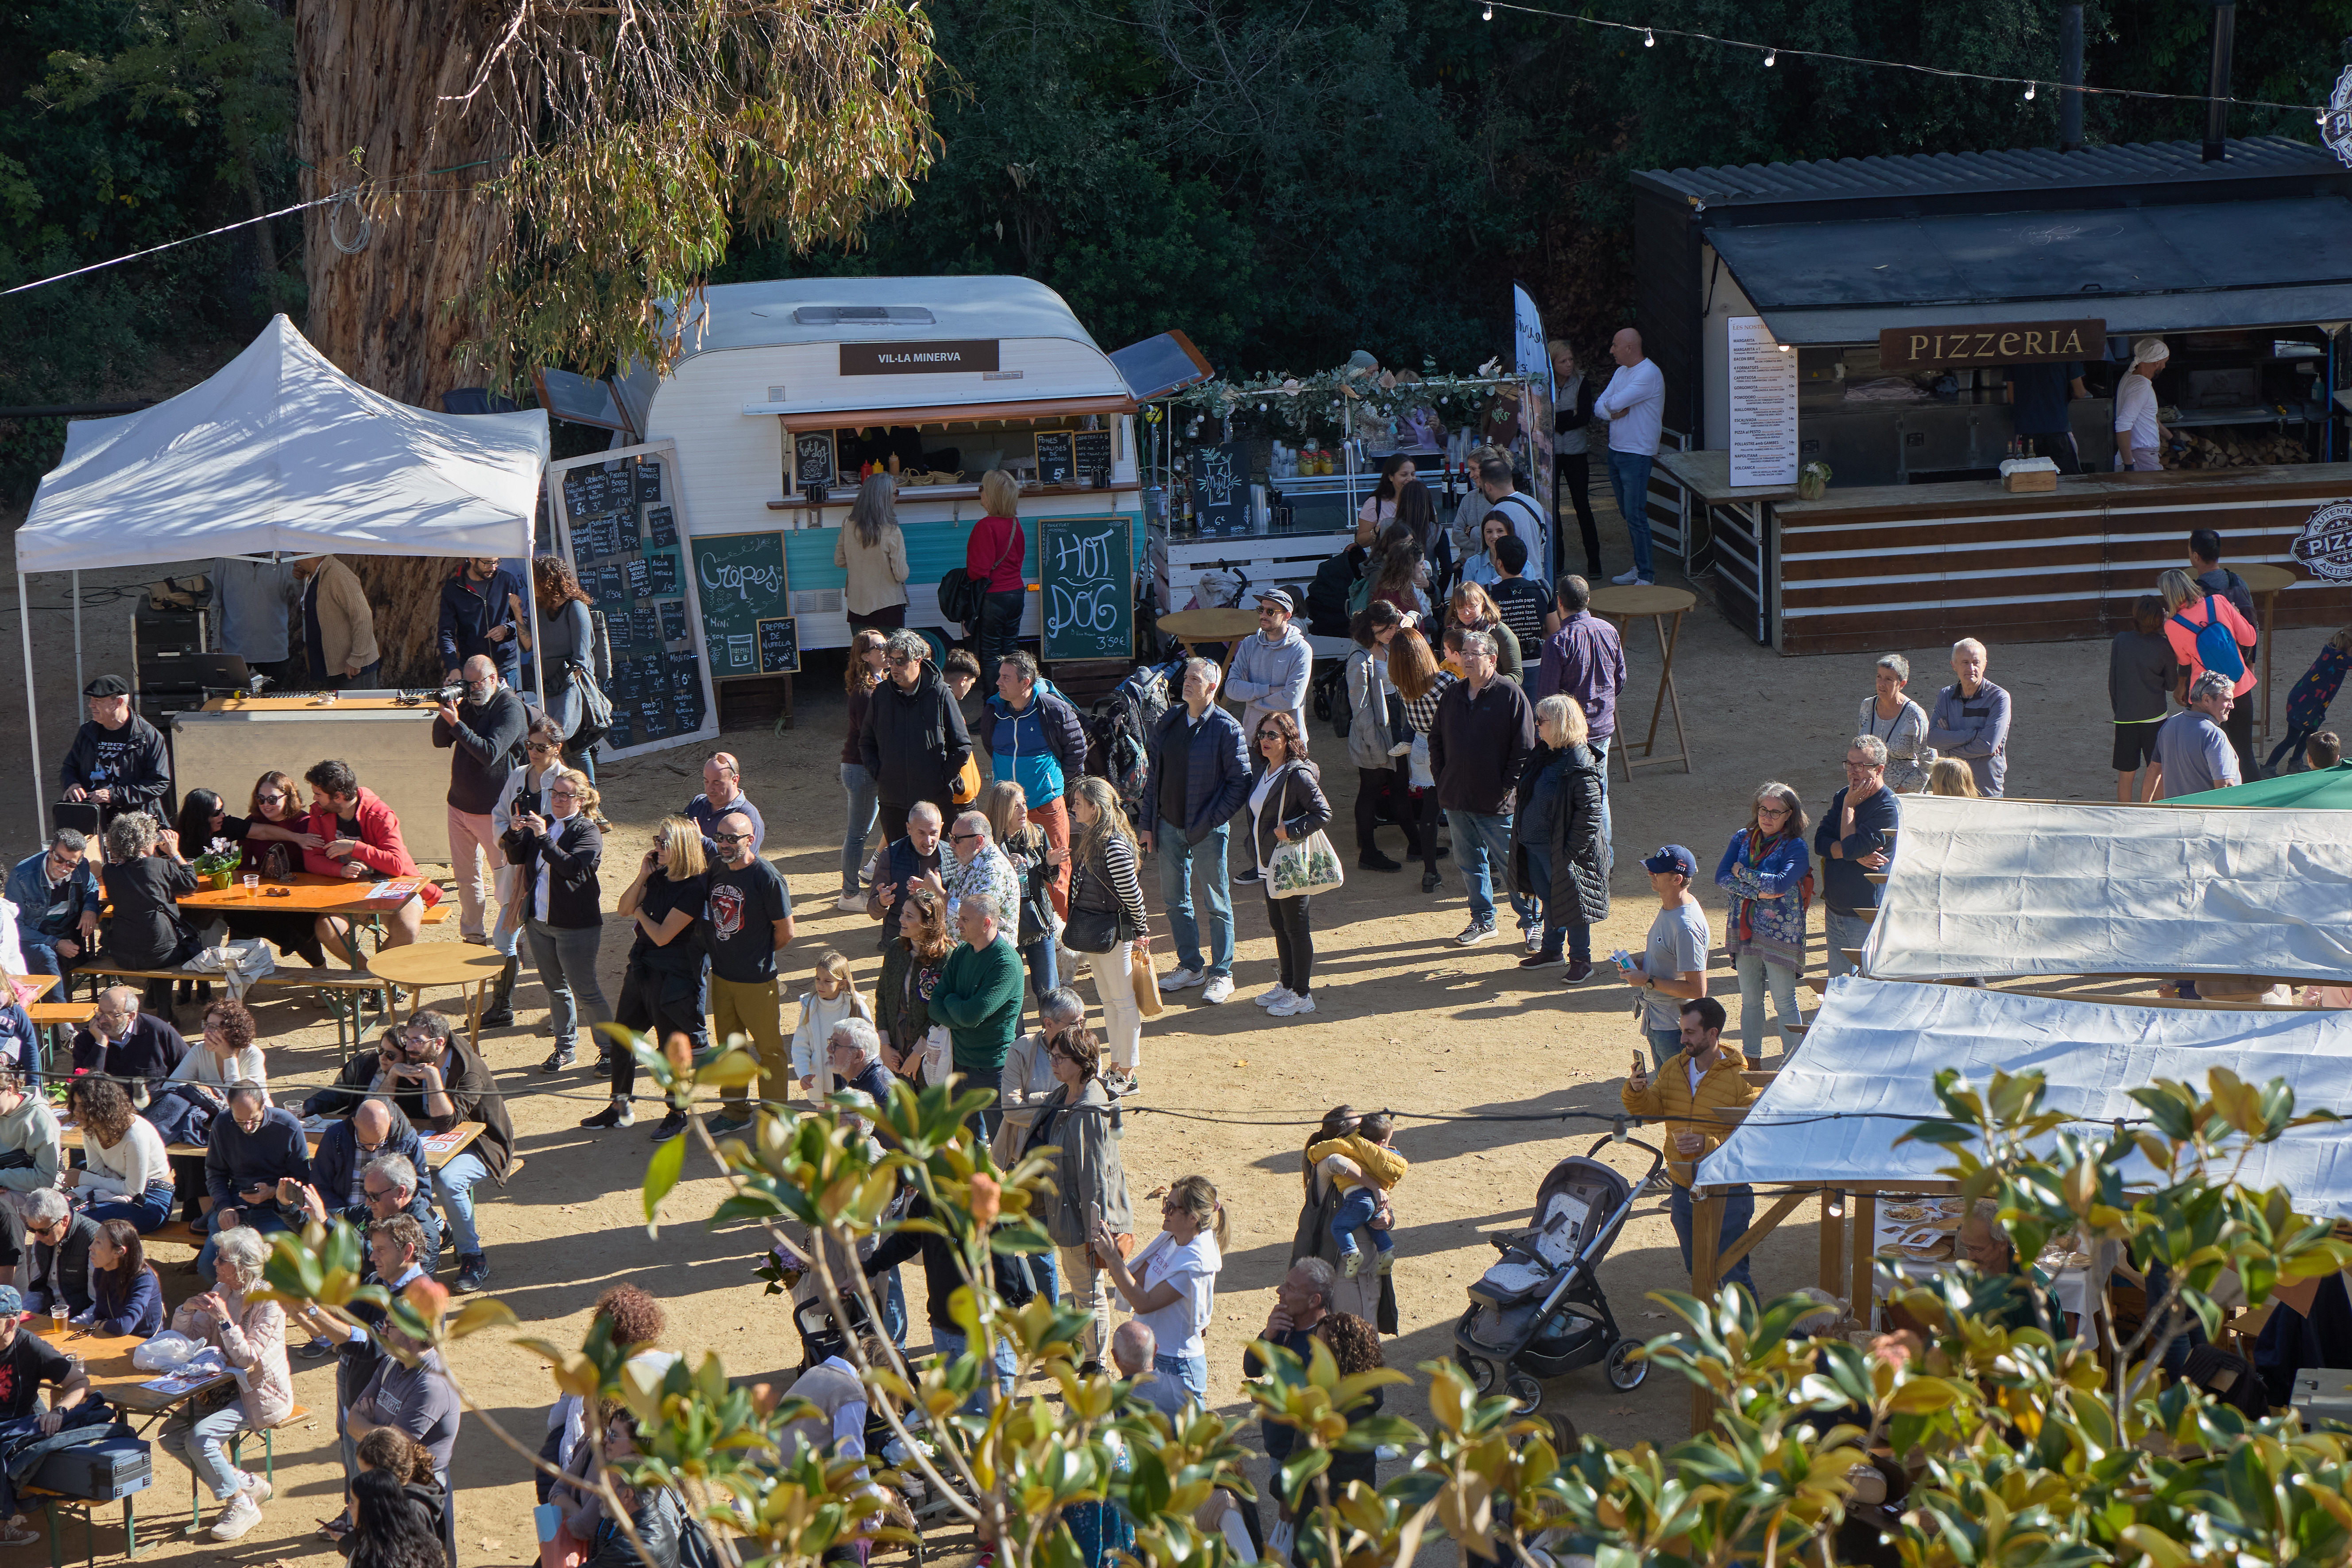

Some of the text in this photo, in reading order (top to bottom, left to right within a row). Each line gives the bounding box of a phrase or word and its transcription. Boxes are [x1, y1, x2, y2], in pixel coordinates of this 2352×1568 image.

[878, 352, 961, 363] VIL·LA MINERVA
[1053, 467, 1066, 480] 5€
[645, 487, 658, 498] 5€
[576, 502, 587, 515] 5€
[592, 501, 601, 511] 3€
[1215, 516, 1226, 526] 6€
[657, 533, 669, 545] 3€
[575, 546, 586, 562] 7€
[1056, 528, 1114, 578] HOT
[701, 552, 779, 599] Crêpes
[1048, 583, 1117, 638] DOG
[760, 622, 791, 632] CREPPES
[762, 640, 791, 649] NUTELLA
[1096, 635, 1126, 649] 3'50€
[763, 652, 776, 667] 3€
[654, 677, 665, 689] 4€
[681, 673, 692, 685] 6€
[603, 680, 614, 692] 6€
[682, 719, 696, 729] 3€
[613, 734, 624, 746] 3€
